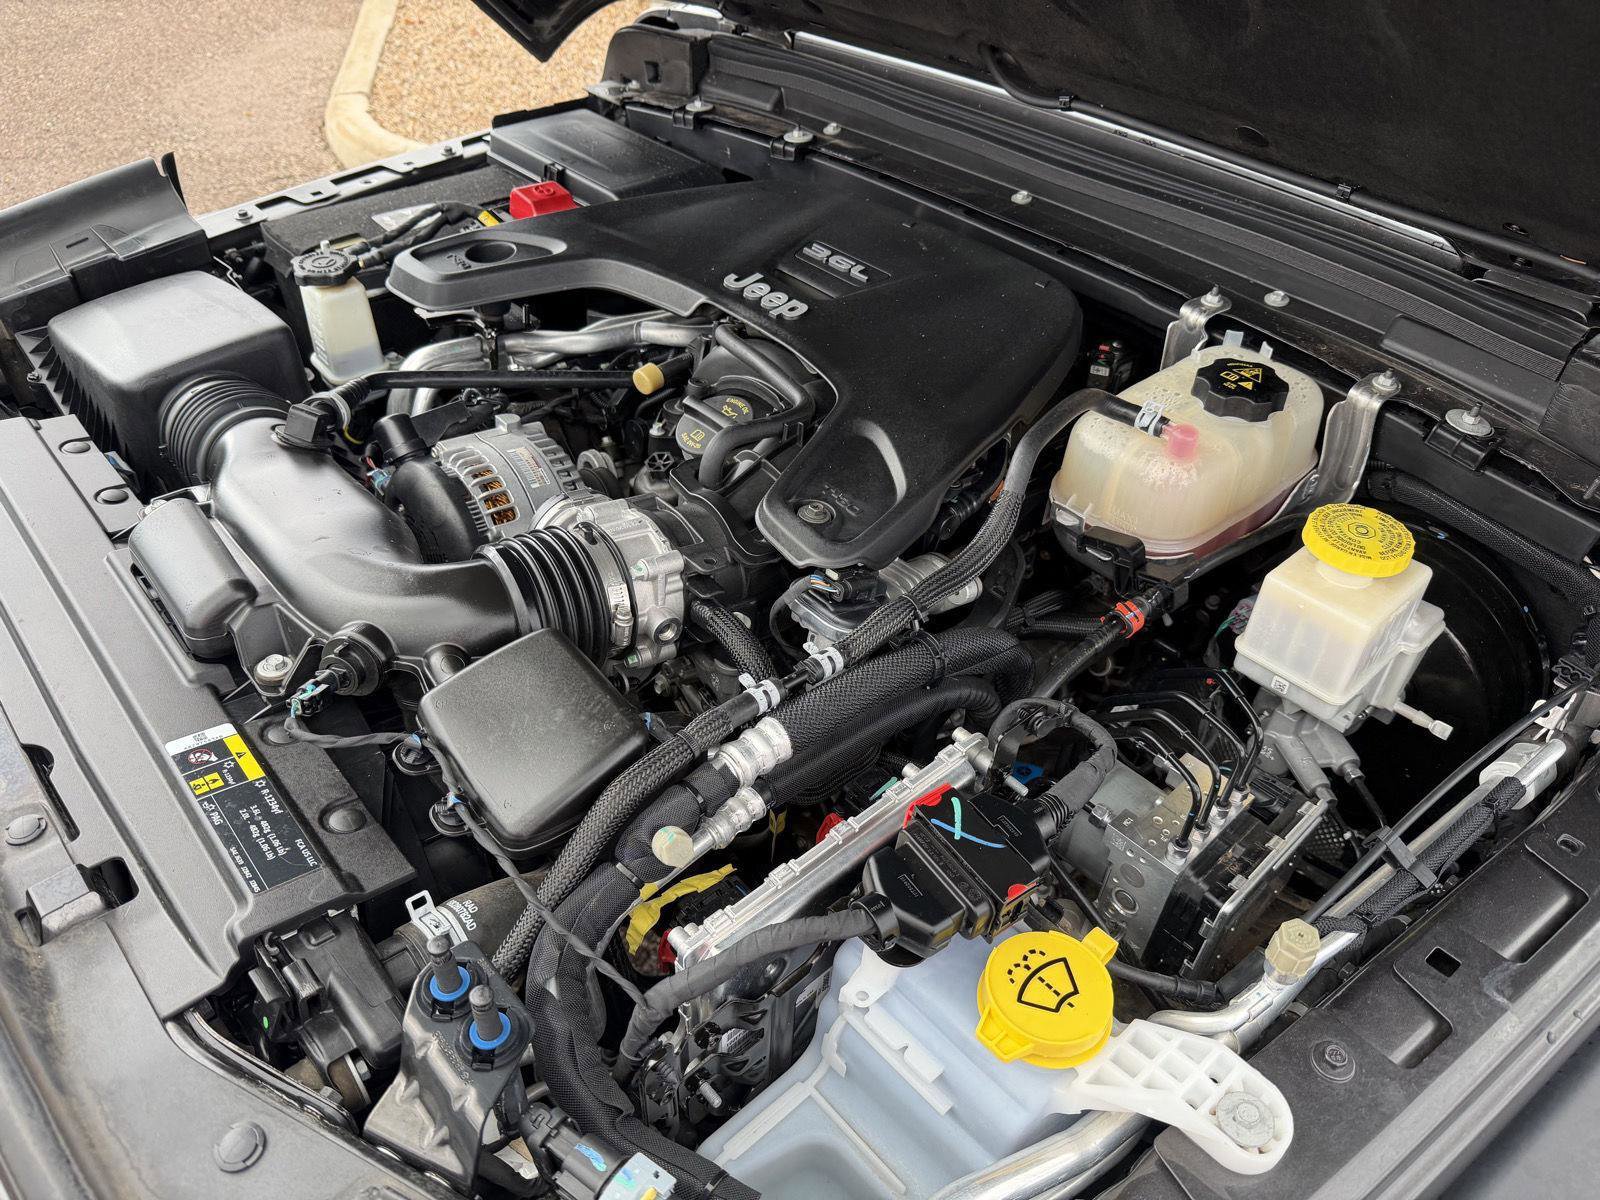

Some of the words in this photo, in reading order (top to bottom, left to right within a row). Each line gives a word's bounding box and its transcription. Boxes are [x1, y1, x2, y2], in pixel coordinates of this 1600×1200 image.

[802, 243, 869, 283] 3.6L
[723, 272, 809, 321] Jeep
[260, 788, 284, 815] R-1234yf
[239, 808, 251, 821] 2.0L
[250, 804, 262, 816] 3.6L
[210, 811, 224, 826] PAG
[229, 846, 239, 856] SAE
[294, 838, 307, 851] FCA
[301, 847, 311, 858] US
[306, 854, 318, 867] LLC
[462, 899, 479, 914] RAD
